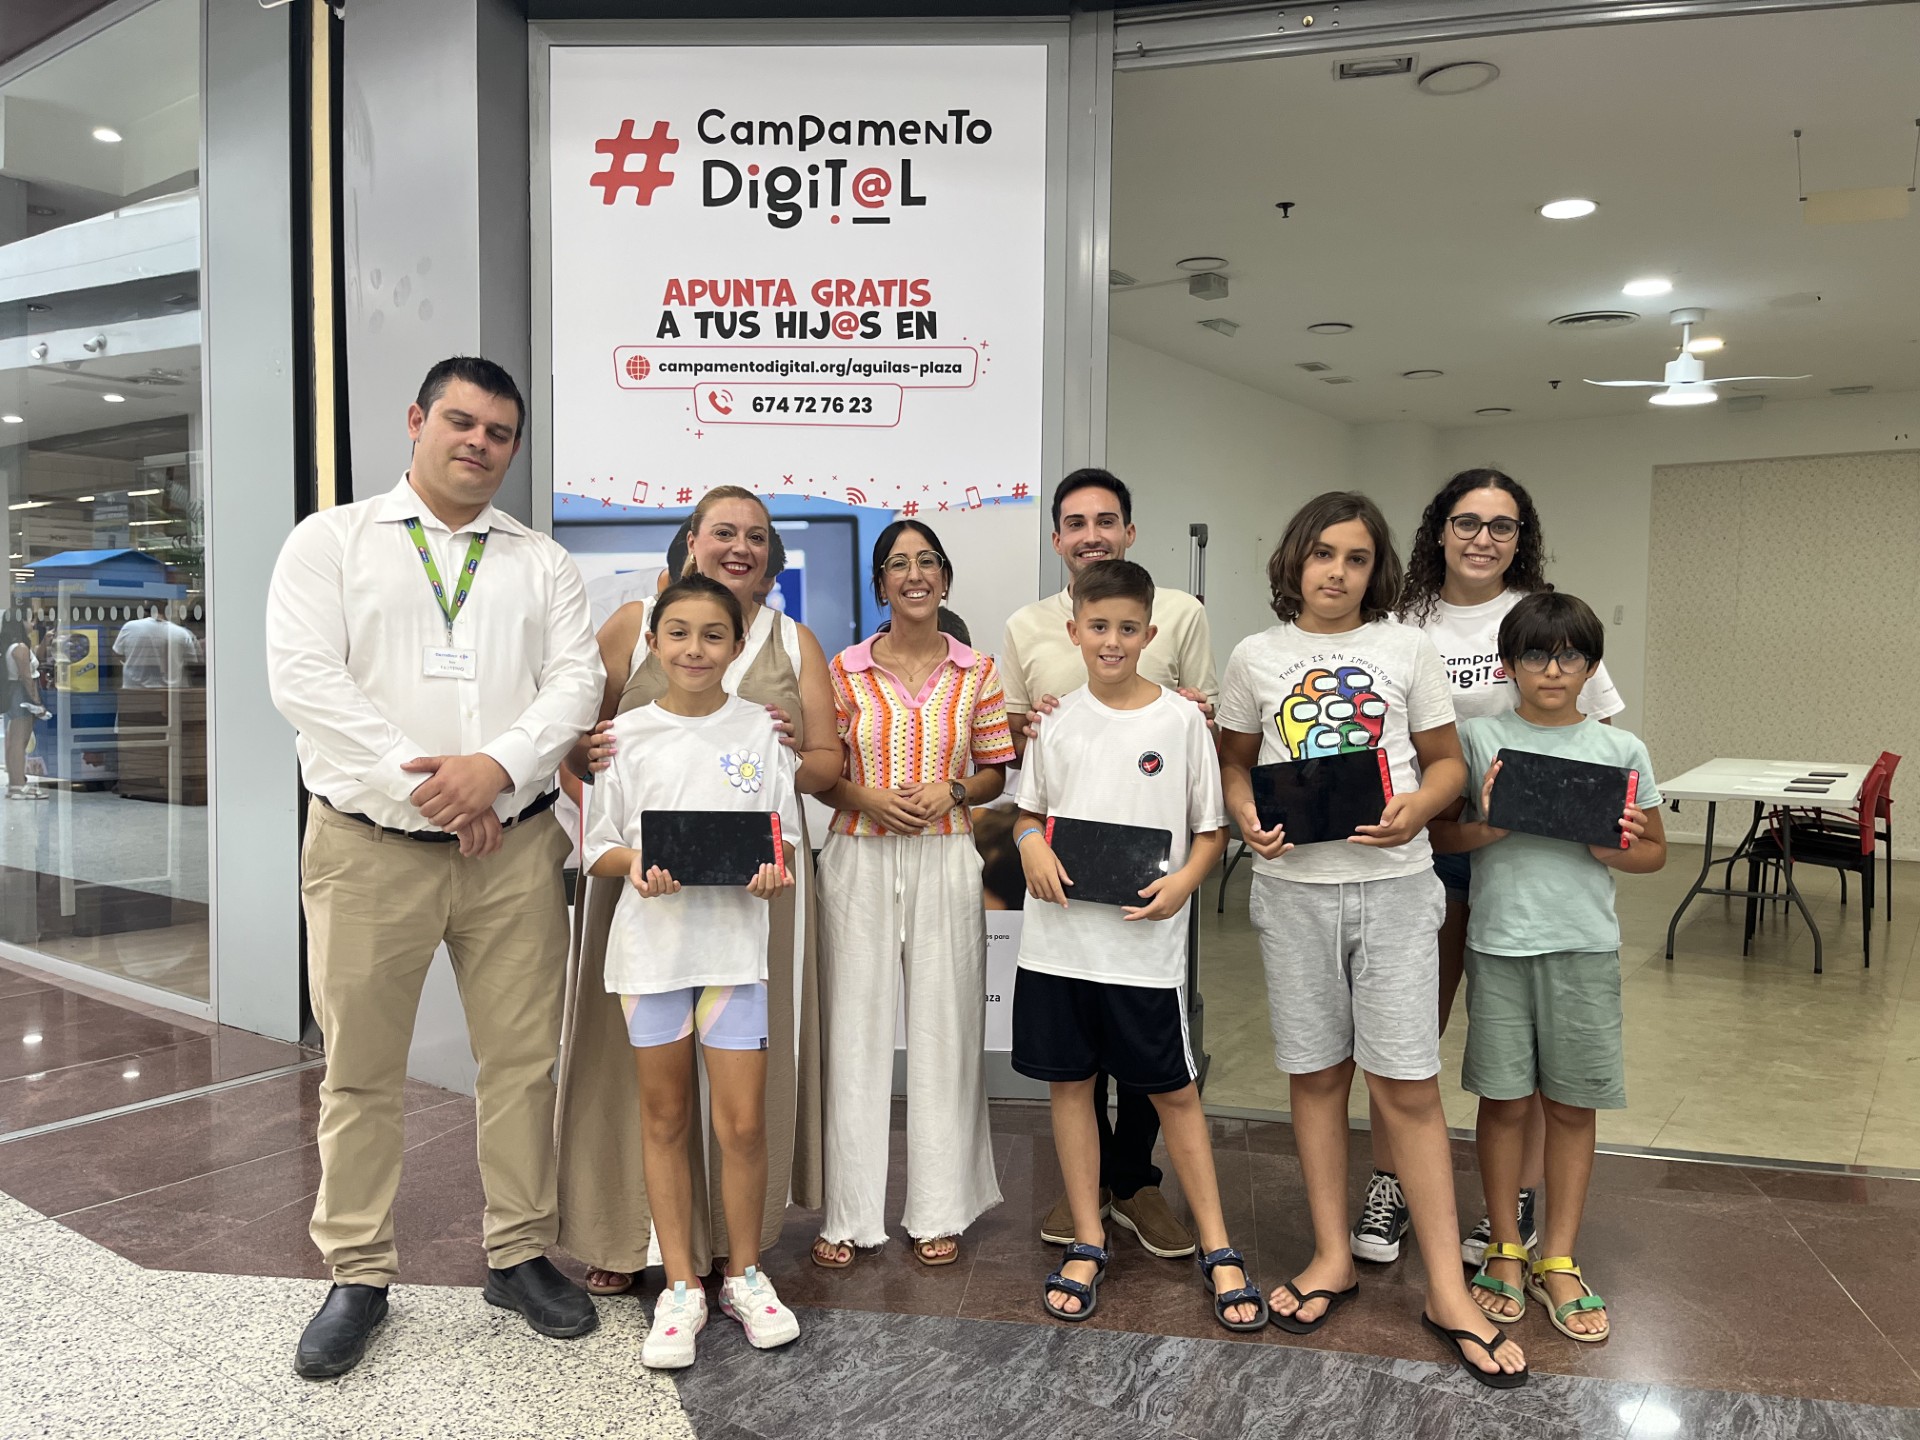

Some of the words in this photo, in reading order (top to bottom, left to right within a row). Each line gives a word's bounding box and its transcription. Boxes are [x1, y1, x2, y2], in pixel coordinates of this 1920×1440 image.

[590, 119, 679, 206] #
[662, 278, 797, 307] APUNTA
[811, 278, 932, 307] GRATIS
[656, 311, 681, 339] A
[694, 311, 761, 339] TUS
[775, 311, 882, 340] HIJ@S
[896, 311, 938, 340] EN
[658, 357, 963, 378] campamentodigital.org/aguilas-plaza
[752, 396, 789, 414] 674
[794, 396, 816, 414] 72
[821, 396, 844, 414] 76
[849, 396, 873, 414] 23
[1279, 660, 1306, 681] THERE
[1311, 654, 1324, 663] IS
[1331, 653, 1344, 661] AN
[1350, 656, 1392, 686] IMPOSTOR
[1440, 653, 1501, 666] ampa
[985, 994, 1001, 1002] aza
